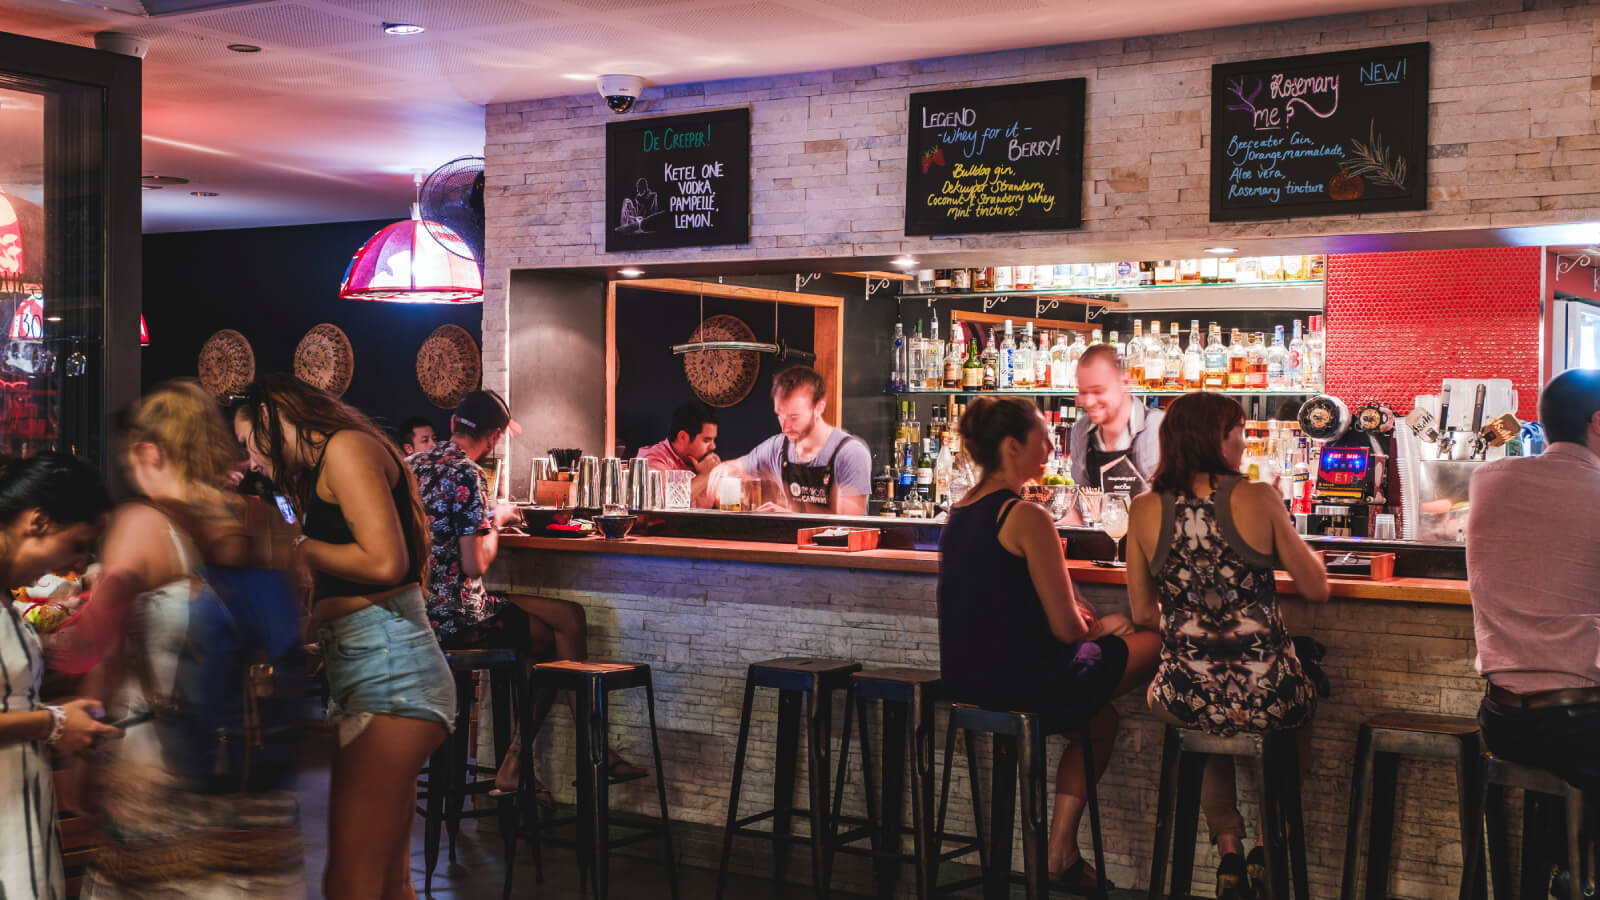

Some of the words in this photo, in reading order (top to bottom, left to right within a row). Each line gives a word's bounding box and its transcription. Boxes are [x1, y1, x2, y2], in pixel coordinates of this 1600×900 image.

[1360, 57, 1407, 86] NEW!
[1270, 73, 1340, 116] Rosemary
[922, 106, 976, 129] LEGEND
[976, 127, 1001, 156] for
[1005, 121, 1019, 138] it
[1008, 135, 1061, 161] BERRY!
[1226, 134, 1285, 167] Beefeater
[1248, 149, 1282, 171] Orange
[664, 162, 697, 182] KETEL
[701, 161, 724, 178] ONE
[952, 163, 991, 184] Bulldog
[1229, 167, 1252, 184] Aloe
[1228, 184, 1280, 202] Rosemary
[1285, 181, 1324, 194] tincture
